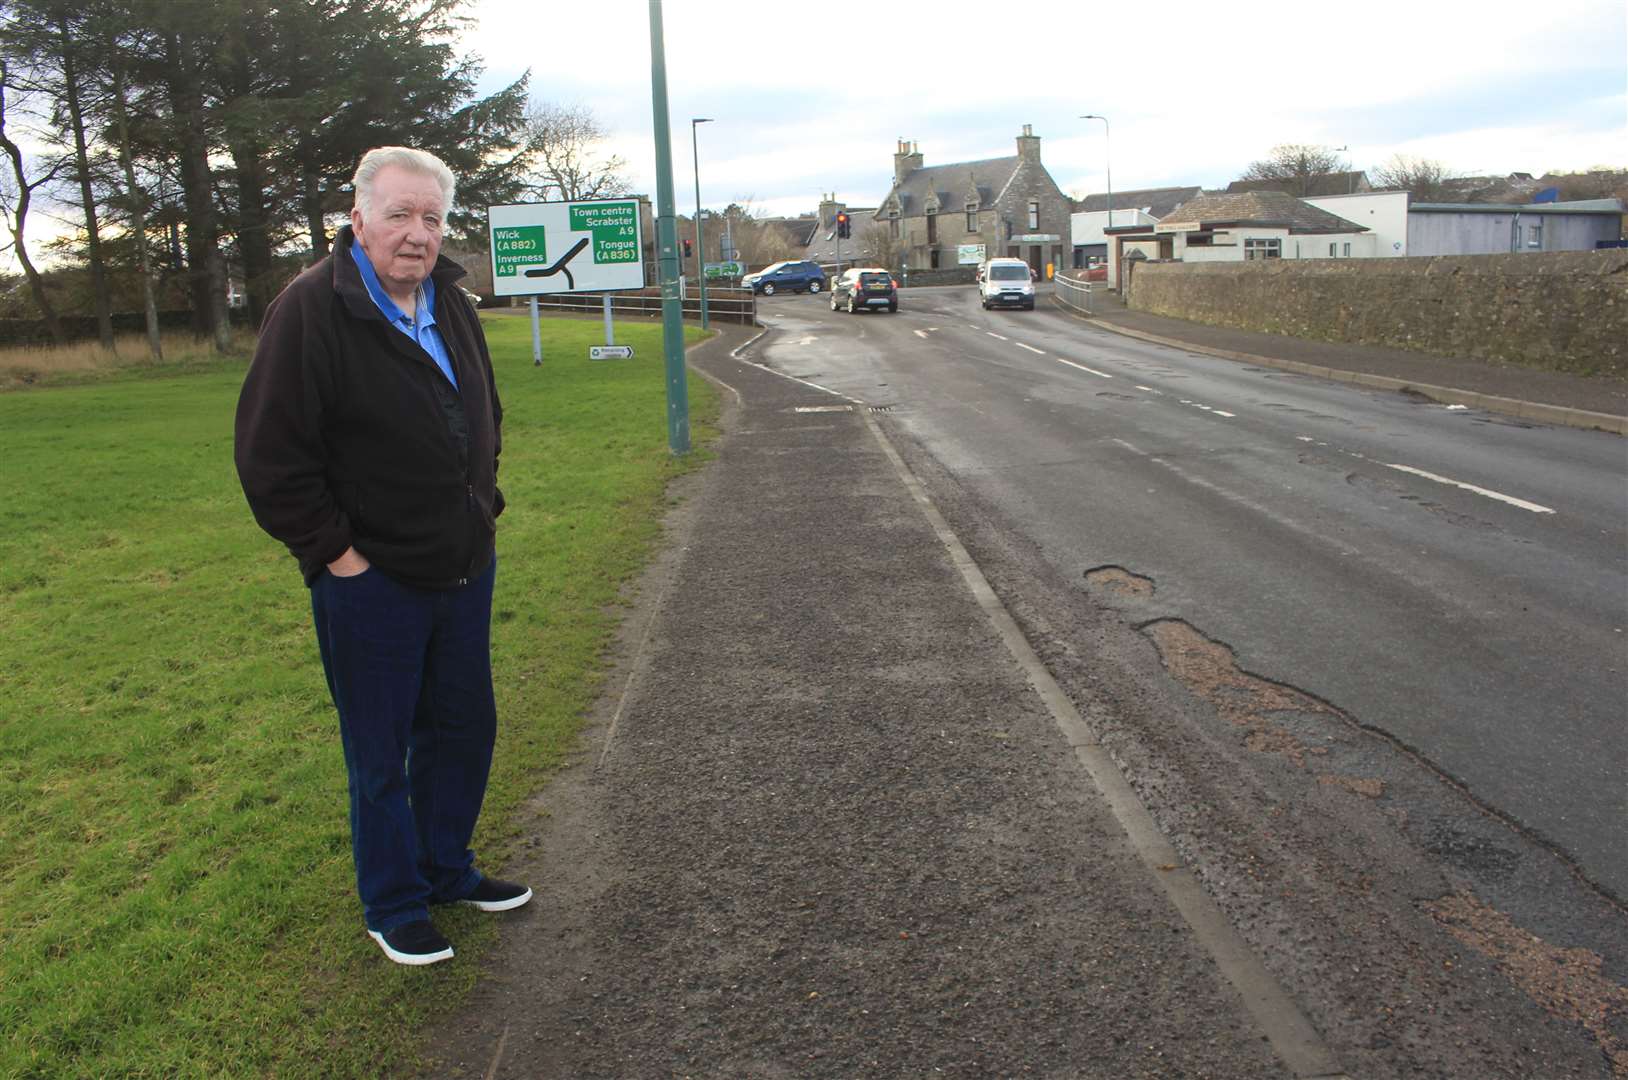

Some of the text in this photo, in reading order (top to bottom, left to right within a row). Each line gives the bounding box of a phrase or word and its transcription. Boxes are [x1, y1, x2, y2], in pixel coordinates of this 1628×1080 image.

[574, 207, 632, 216] Town centre
[586, 217, 633, 226] Scrabster
[496, 231, 519, 239] Wick
[600, 241, 634, 250] Tongue
[497, 254, 543, 263] Inverness
